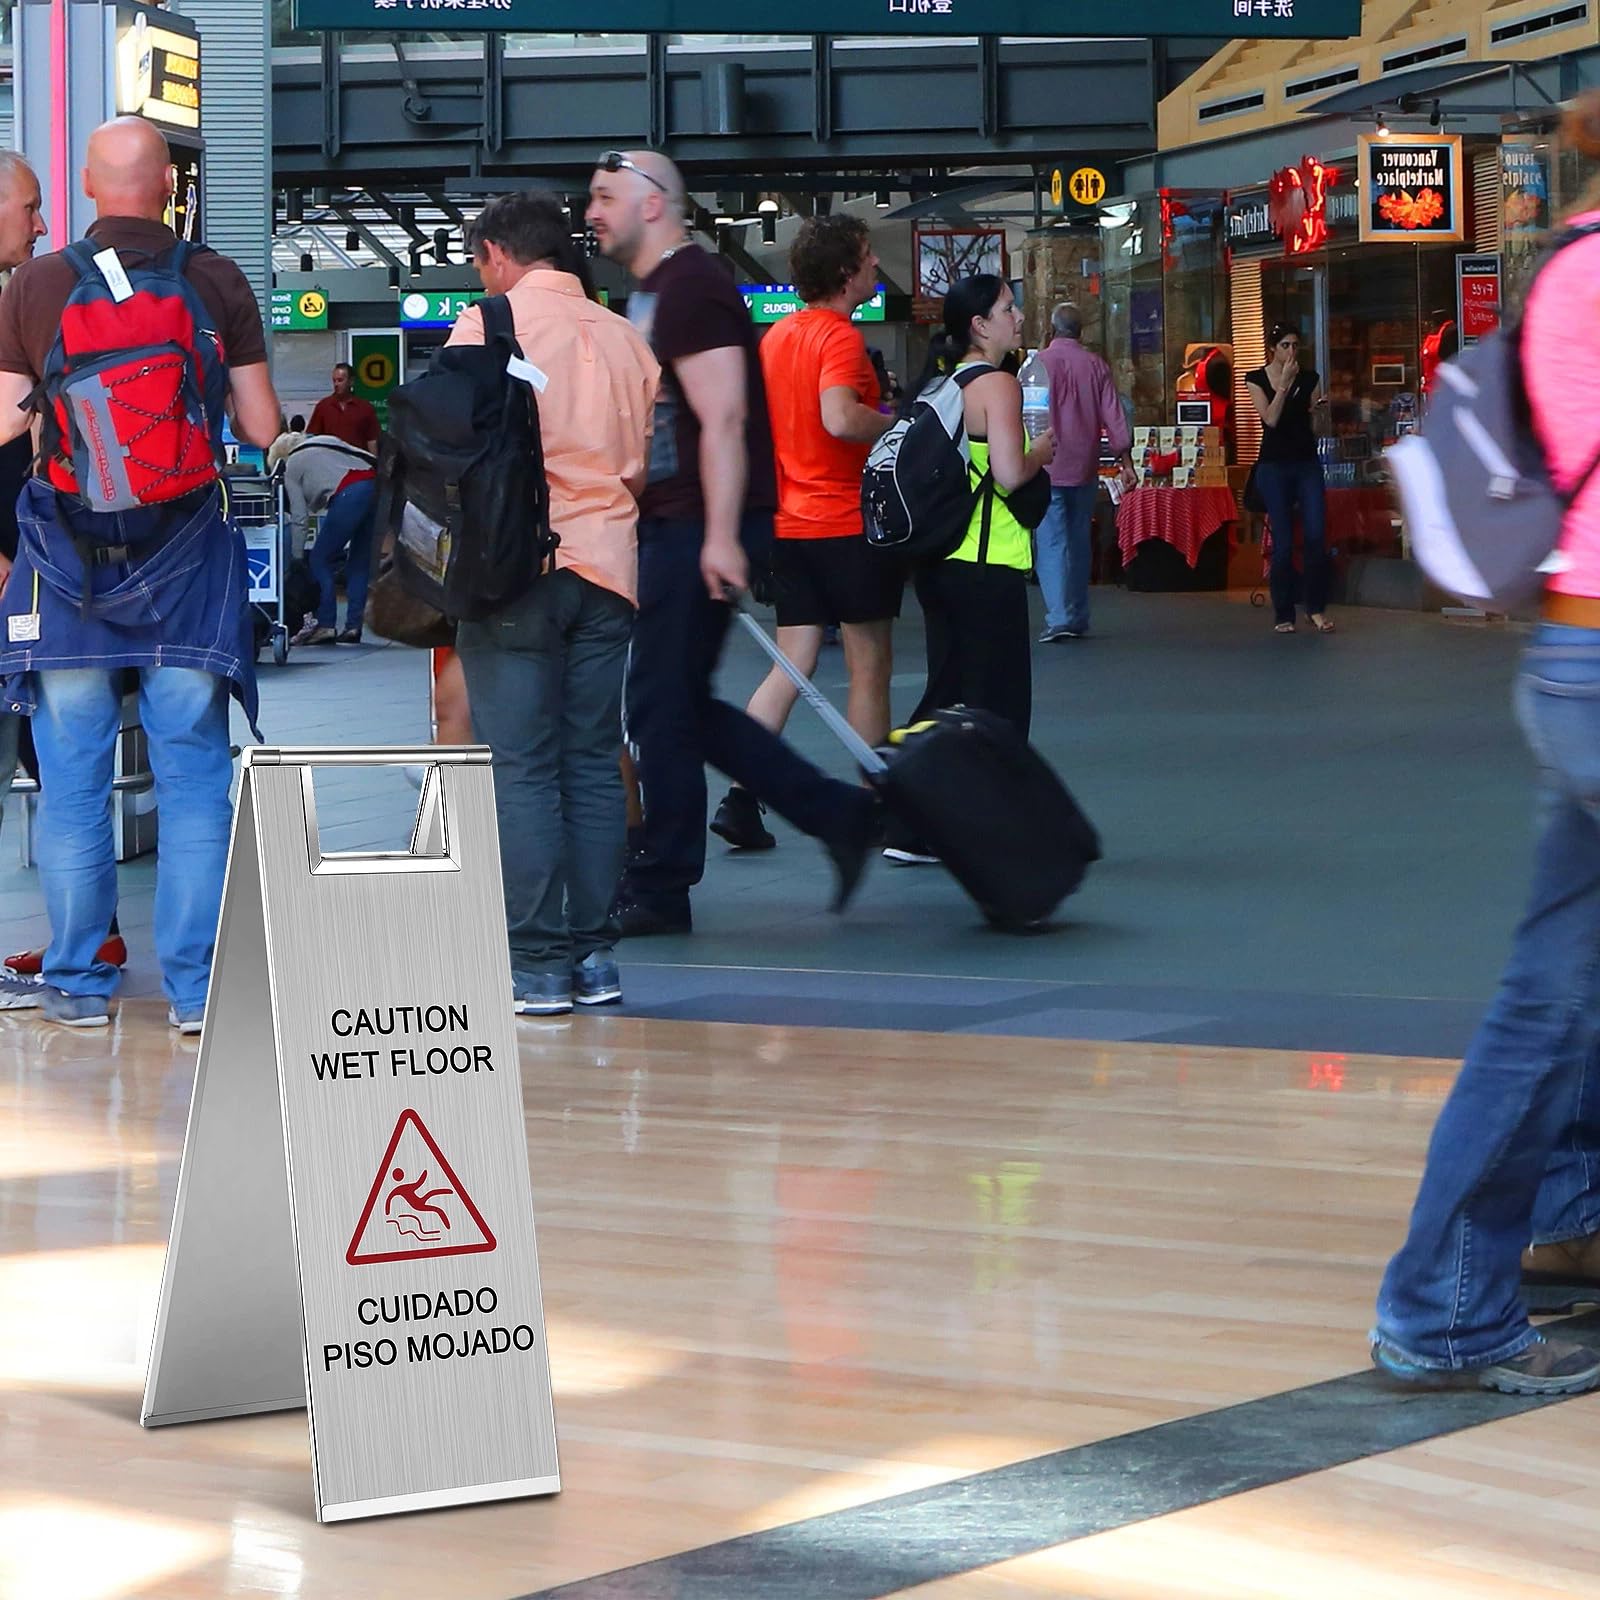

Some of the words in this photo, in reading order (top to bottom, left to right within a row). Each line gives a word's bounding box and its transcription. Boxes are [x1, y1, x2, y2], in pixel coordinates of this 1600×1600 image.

[331, 1004, 469, 1037] CAUTION
[311, 1050, 380, 1081] WET
[391, 1045, 494, 1077] FLOOR
[357, 1286, 498, 1325] CUIDADO
[323, 1338, 397, 1372] PISO
[407, 1324, 535, 1363] MOJADO
